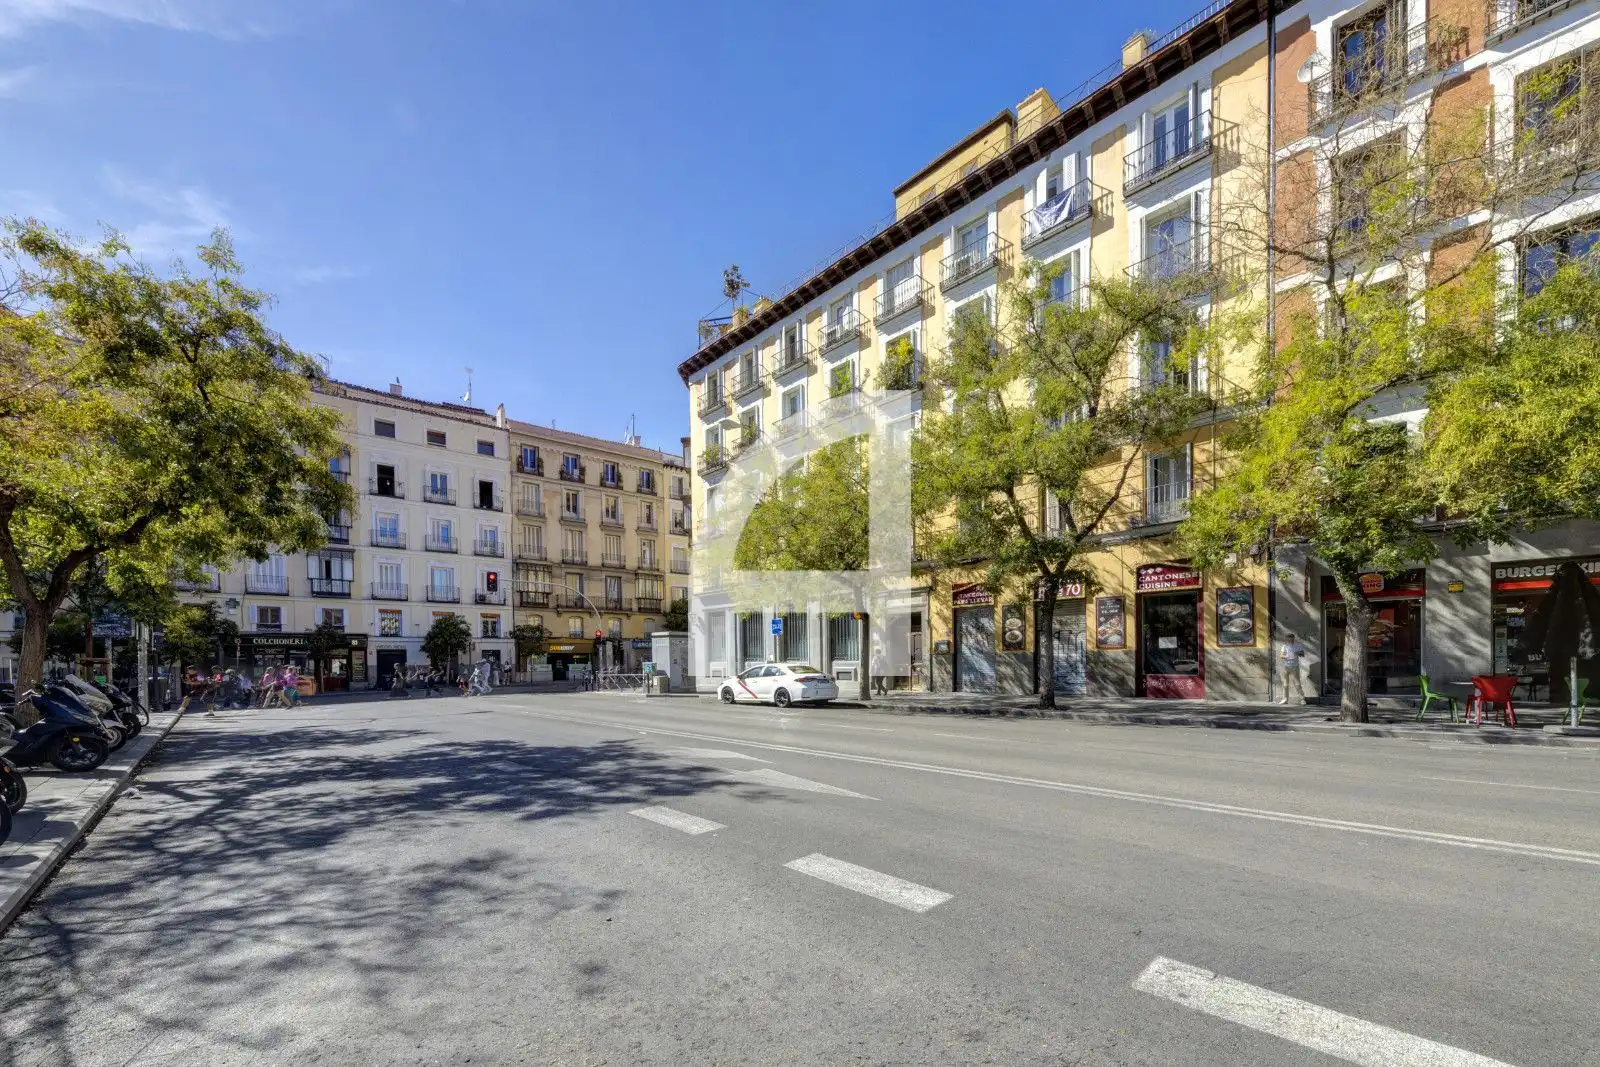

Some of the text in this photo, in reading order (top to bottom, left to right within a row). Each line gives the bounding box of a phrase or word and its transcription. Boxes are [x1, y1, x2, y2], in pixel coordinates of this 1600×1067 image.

[1139, 572, 1198, 583] CANTONESE
[1066, 583, 1081, 595] 70
[1139, 581, 1178, 590] CUISINE
